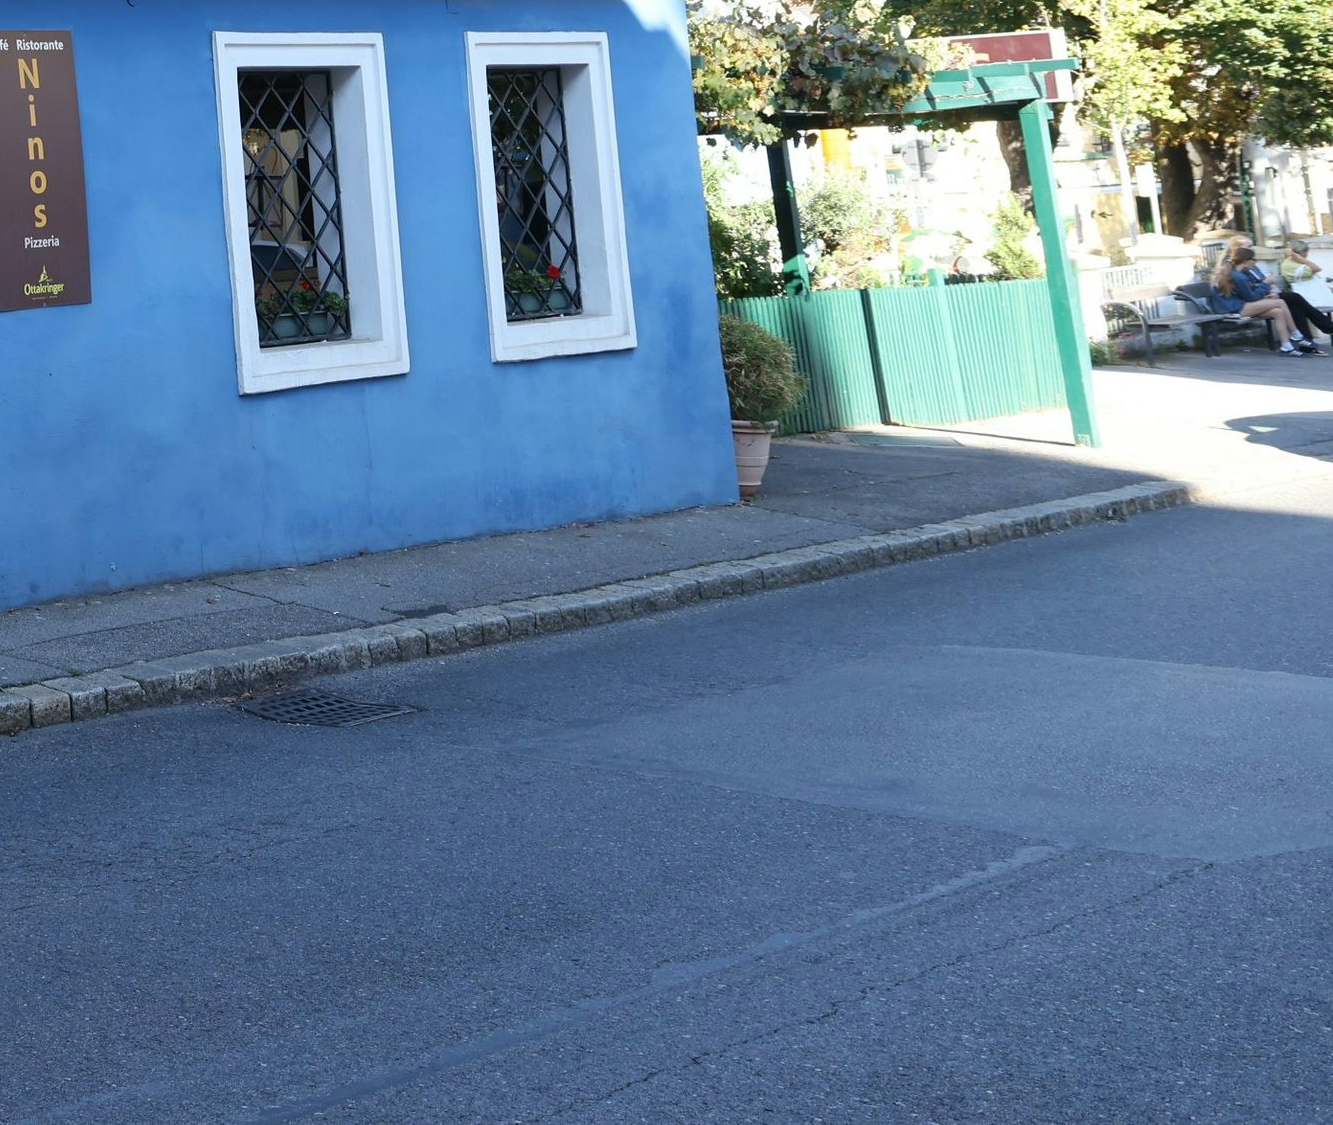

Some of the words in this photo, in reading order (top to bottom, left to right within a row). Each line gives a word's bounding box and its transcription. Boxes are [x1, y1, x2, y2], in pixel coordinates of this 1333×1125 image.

[16, 38, 64, 51] Ristorante
[18, 58, 48, 228] Ninos
[24, 235, 60, 249] Pizzeria
[24, 283, 64, 296] Ottakringer
